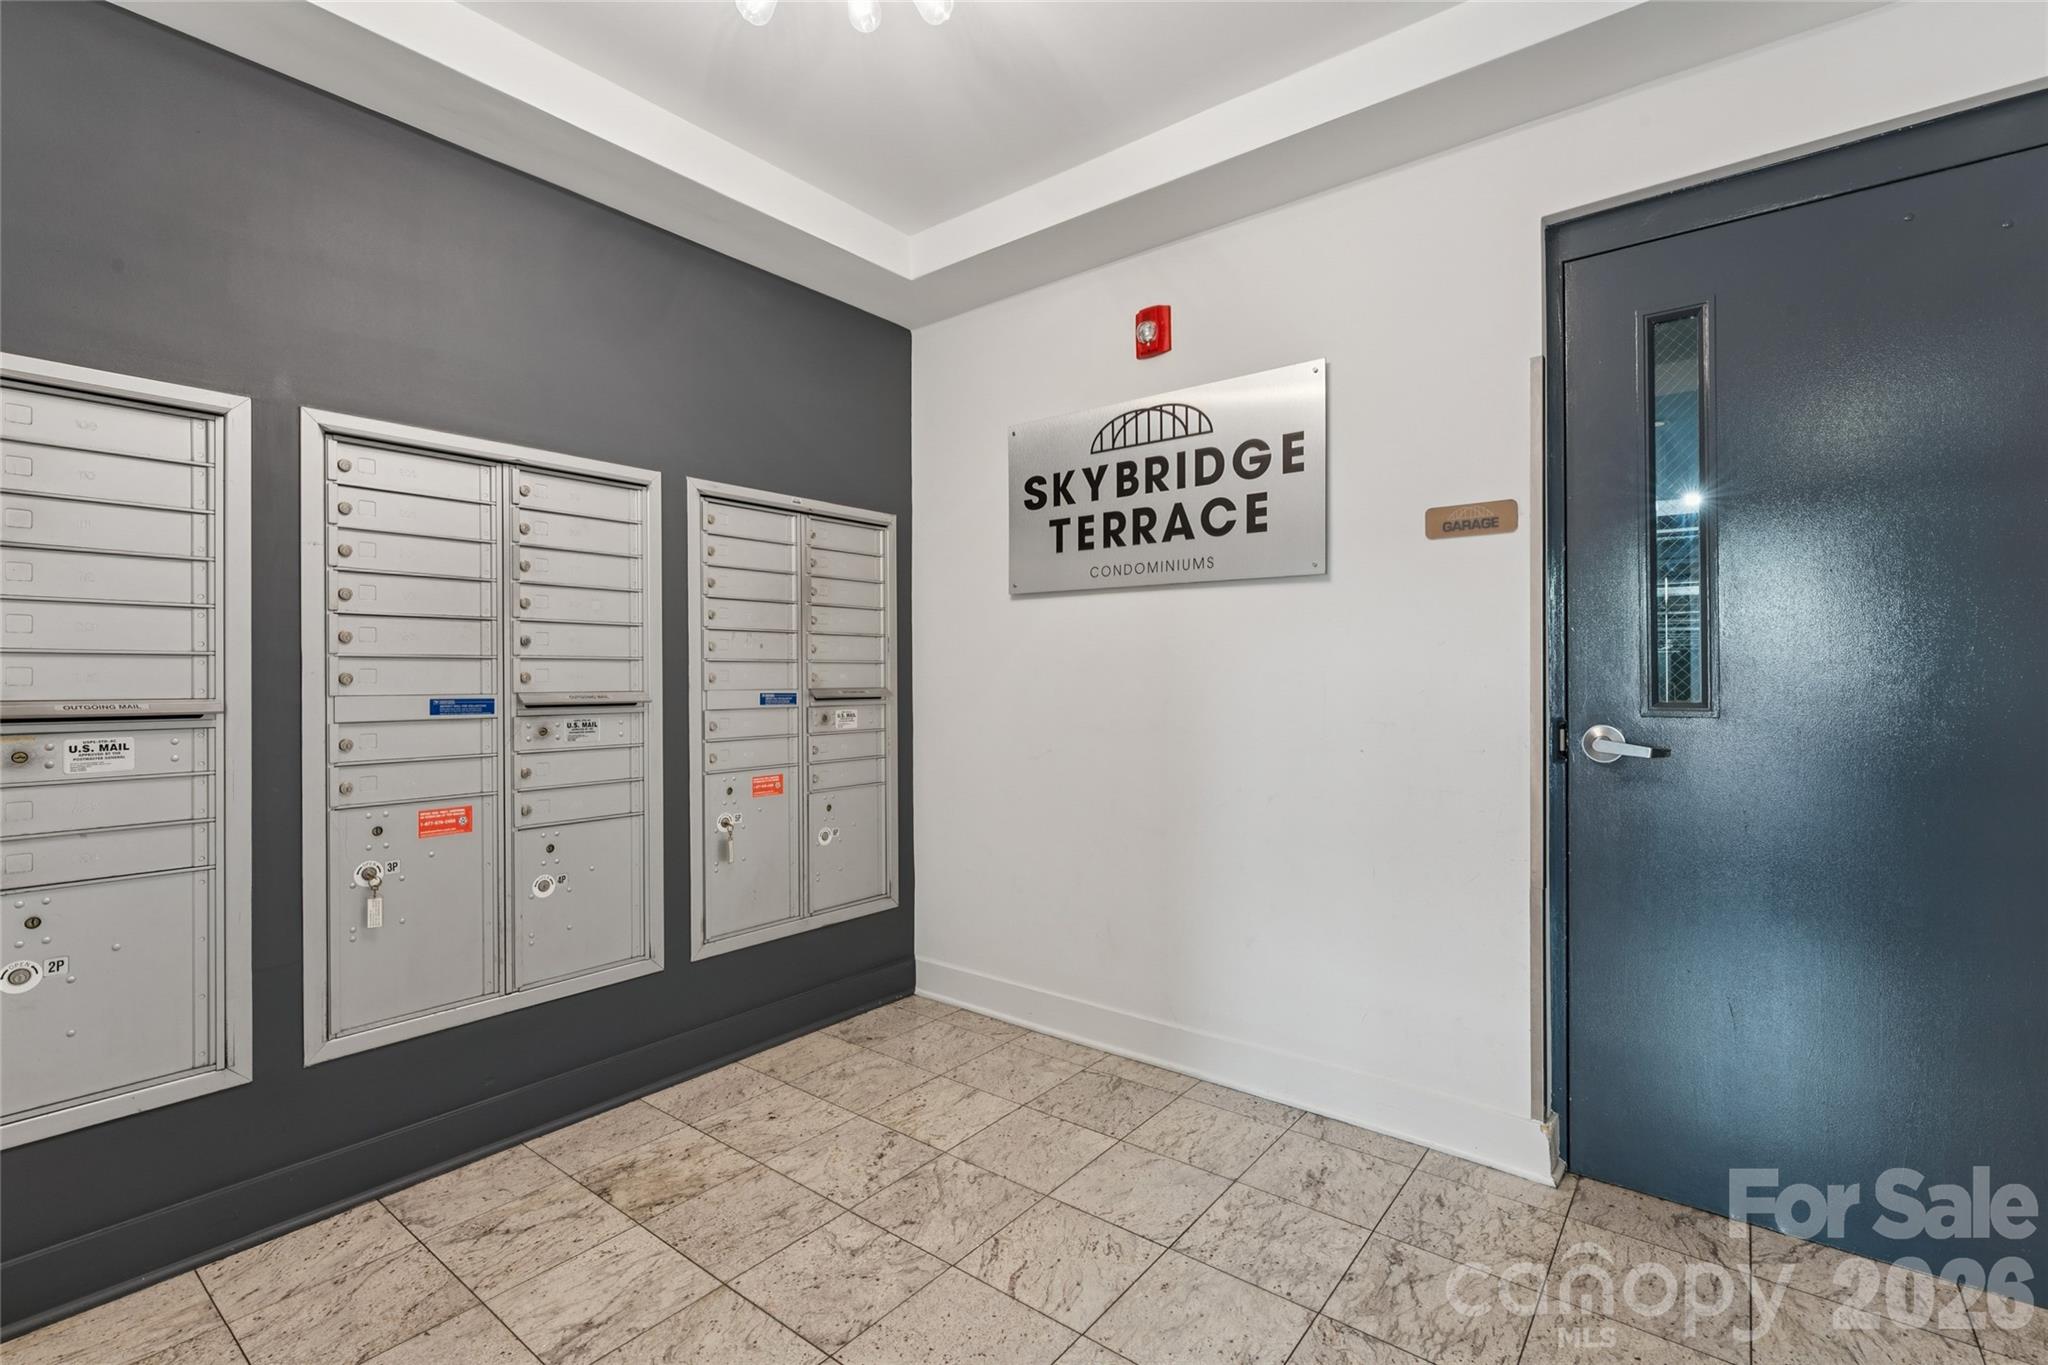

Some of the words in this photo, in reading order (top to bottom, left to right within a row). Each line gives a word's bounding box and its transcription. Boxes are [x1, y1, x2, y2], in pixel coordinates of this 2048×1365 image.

[1023, 431, 1305, 511] SKYBRIDGE
[1049, 491, 1268, 554] TERRACE
[1442, 516, 1500, 533] GARAGE
[1089, 556, 1215, 579] CONDOMINIUMS
[68, 745, 94, 753] U.S.
[99, 743, 130, 752] MAIL
[387, 861, 399, 873] 3P
[557, 874, 567, 884] 4P
[47, 959, 65, 974] 2P
